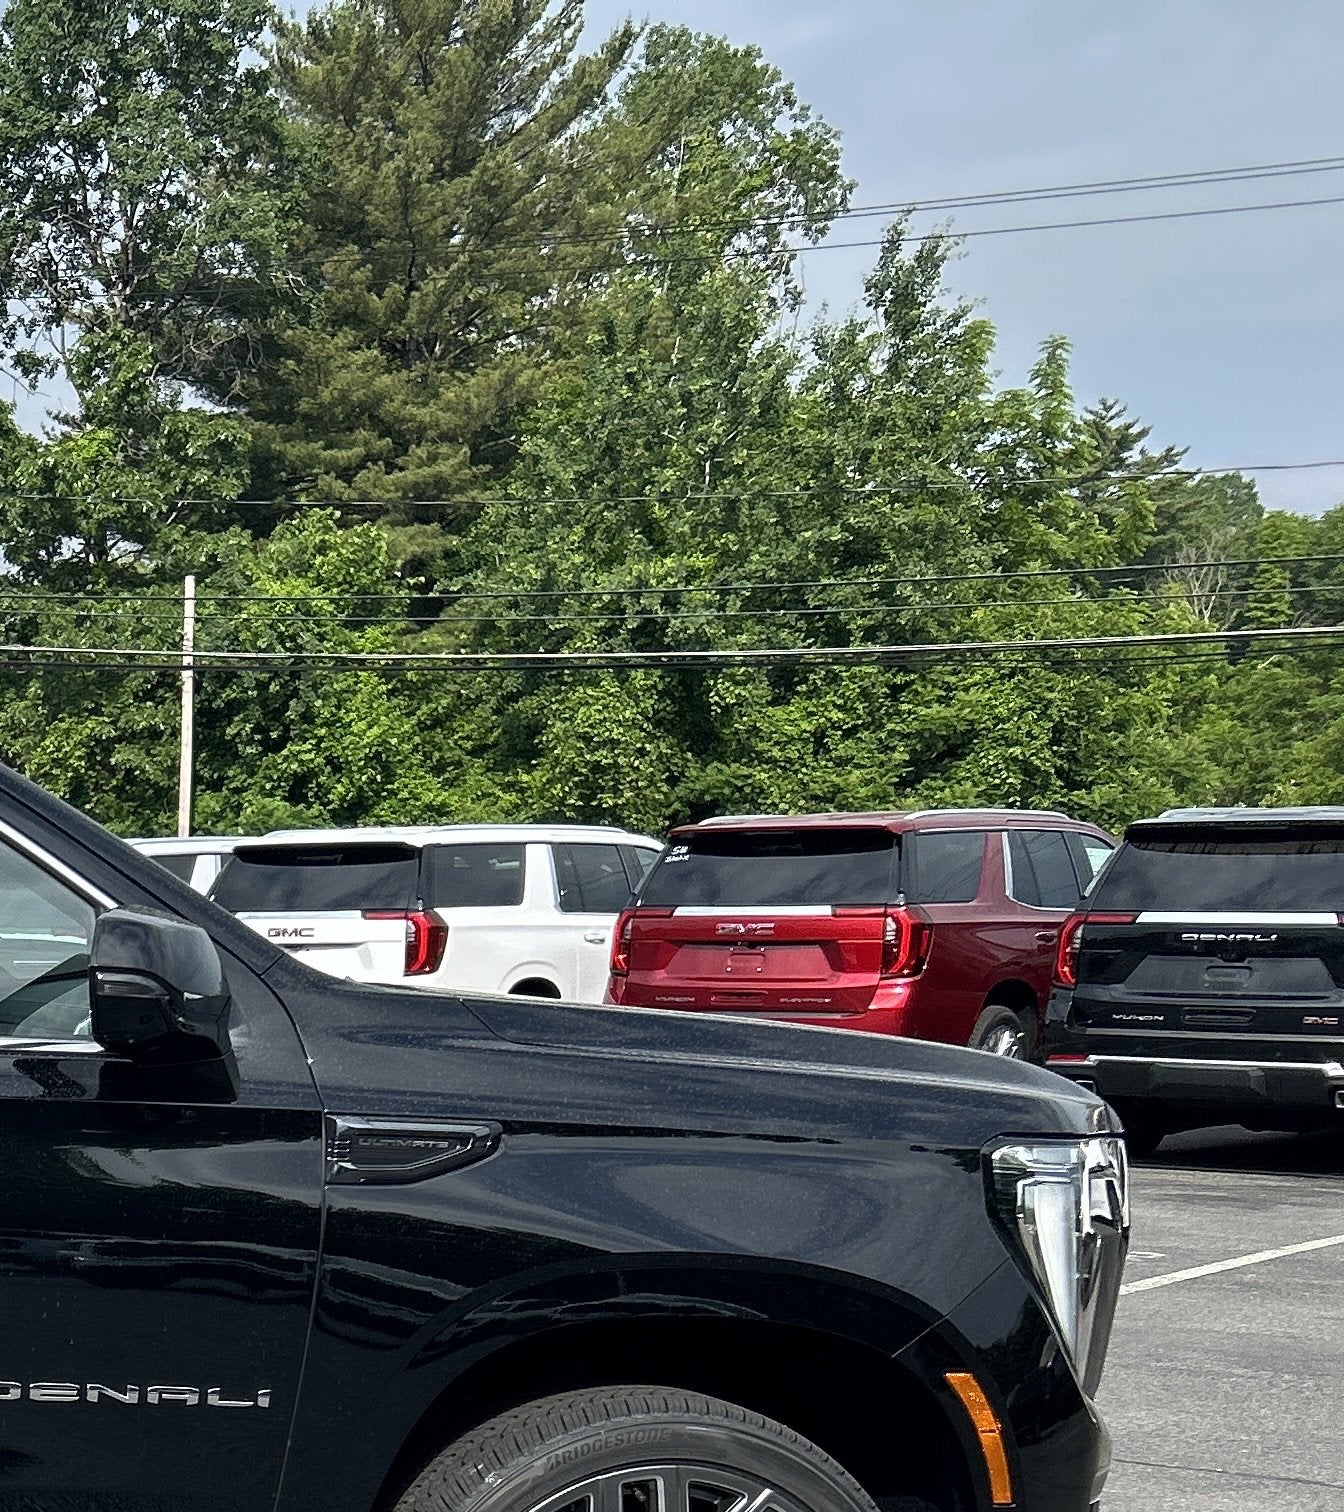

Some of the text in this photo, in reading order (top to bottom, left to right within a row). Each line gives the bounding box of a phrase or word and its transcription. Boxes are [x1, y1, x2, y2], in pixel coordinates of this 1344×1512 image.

[267, 927, 315, 938] GMC
[1181, 933, 1278, 942] DENALI
[358, 1138, 449, 1148] ULTIMATE
[546, 1428, 671, 1472] BRIDGESTONE
